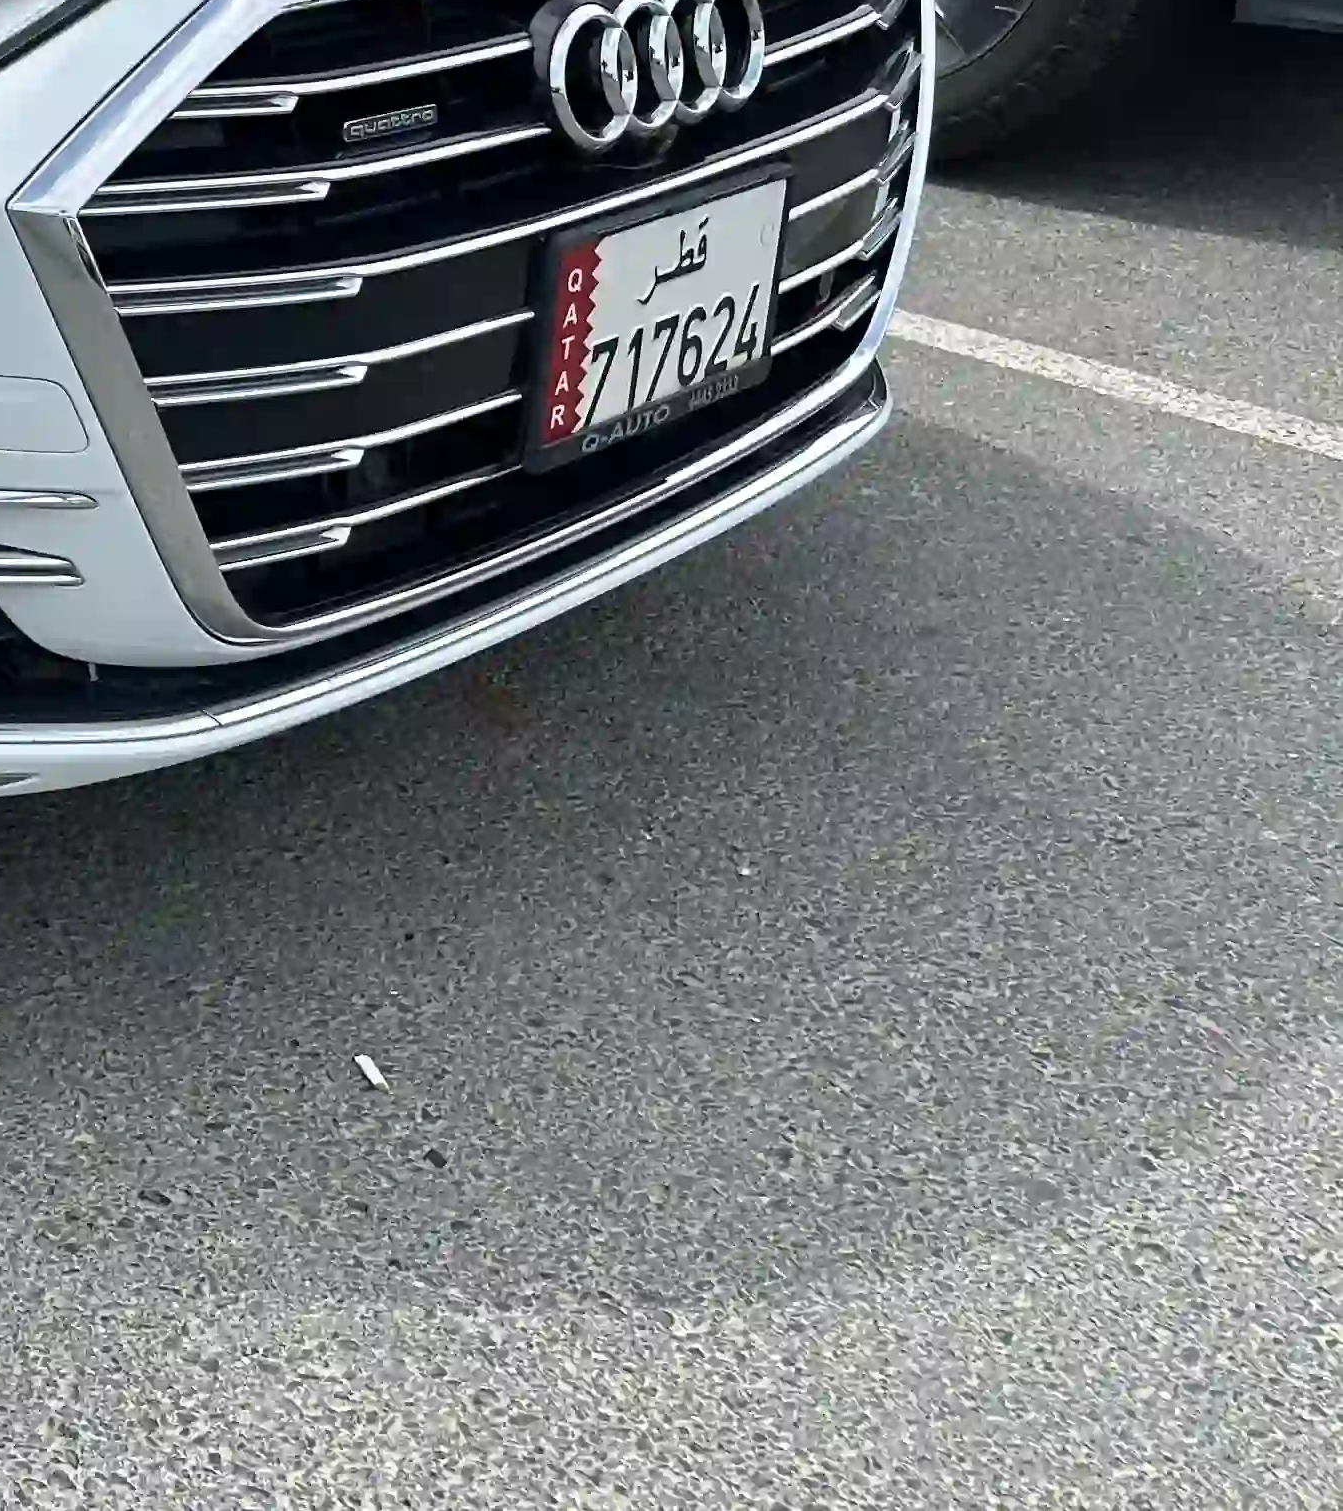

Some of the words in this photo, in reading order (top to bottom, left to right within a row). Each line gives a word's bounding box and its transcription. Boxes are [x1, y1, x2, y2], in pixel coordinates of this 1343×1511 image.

[350, 109, 434, 139] quattro
[636, 213, 710, 306] قطر
[549, 267, 584, 430] QATAR
[584, 282, 761, 429] 717624
[580, 404, 672, 453] Q-AUTO
